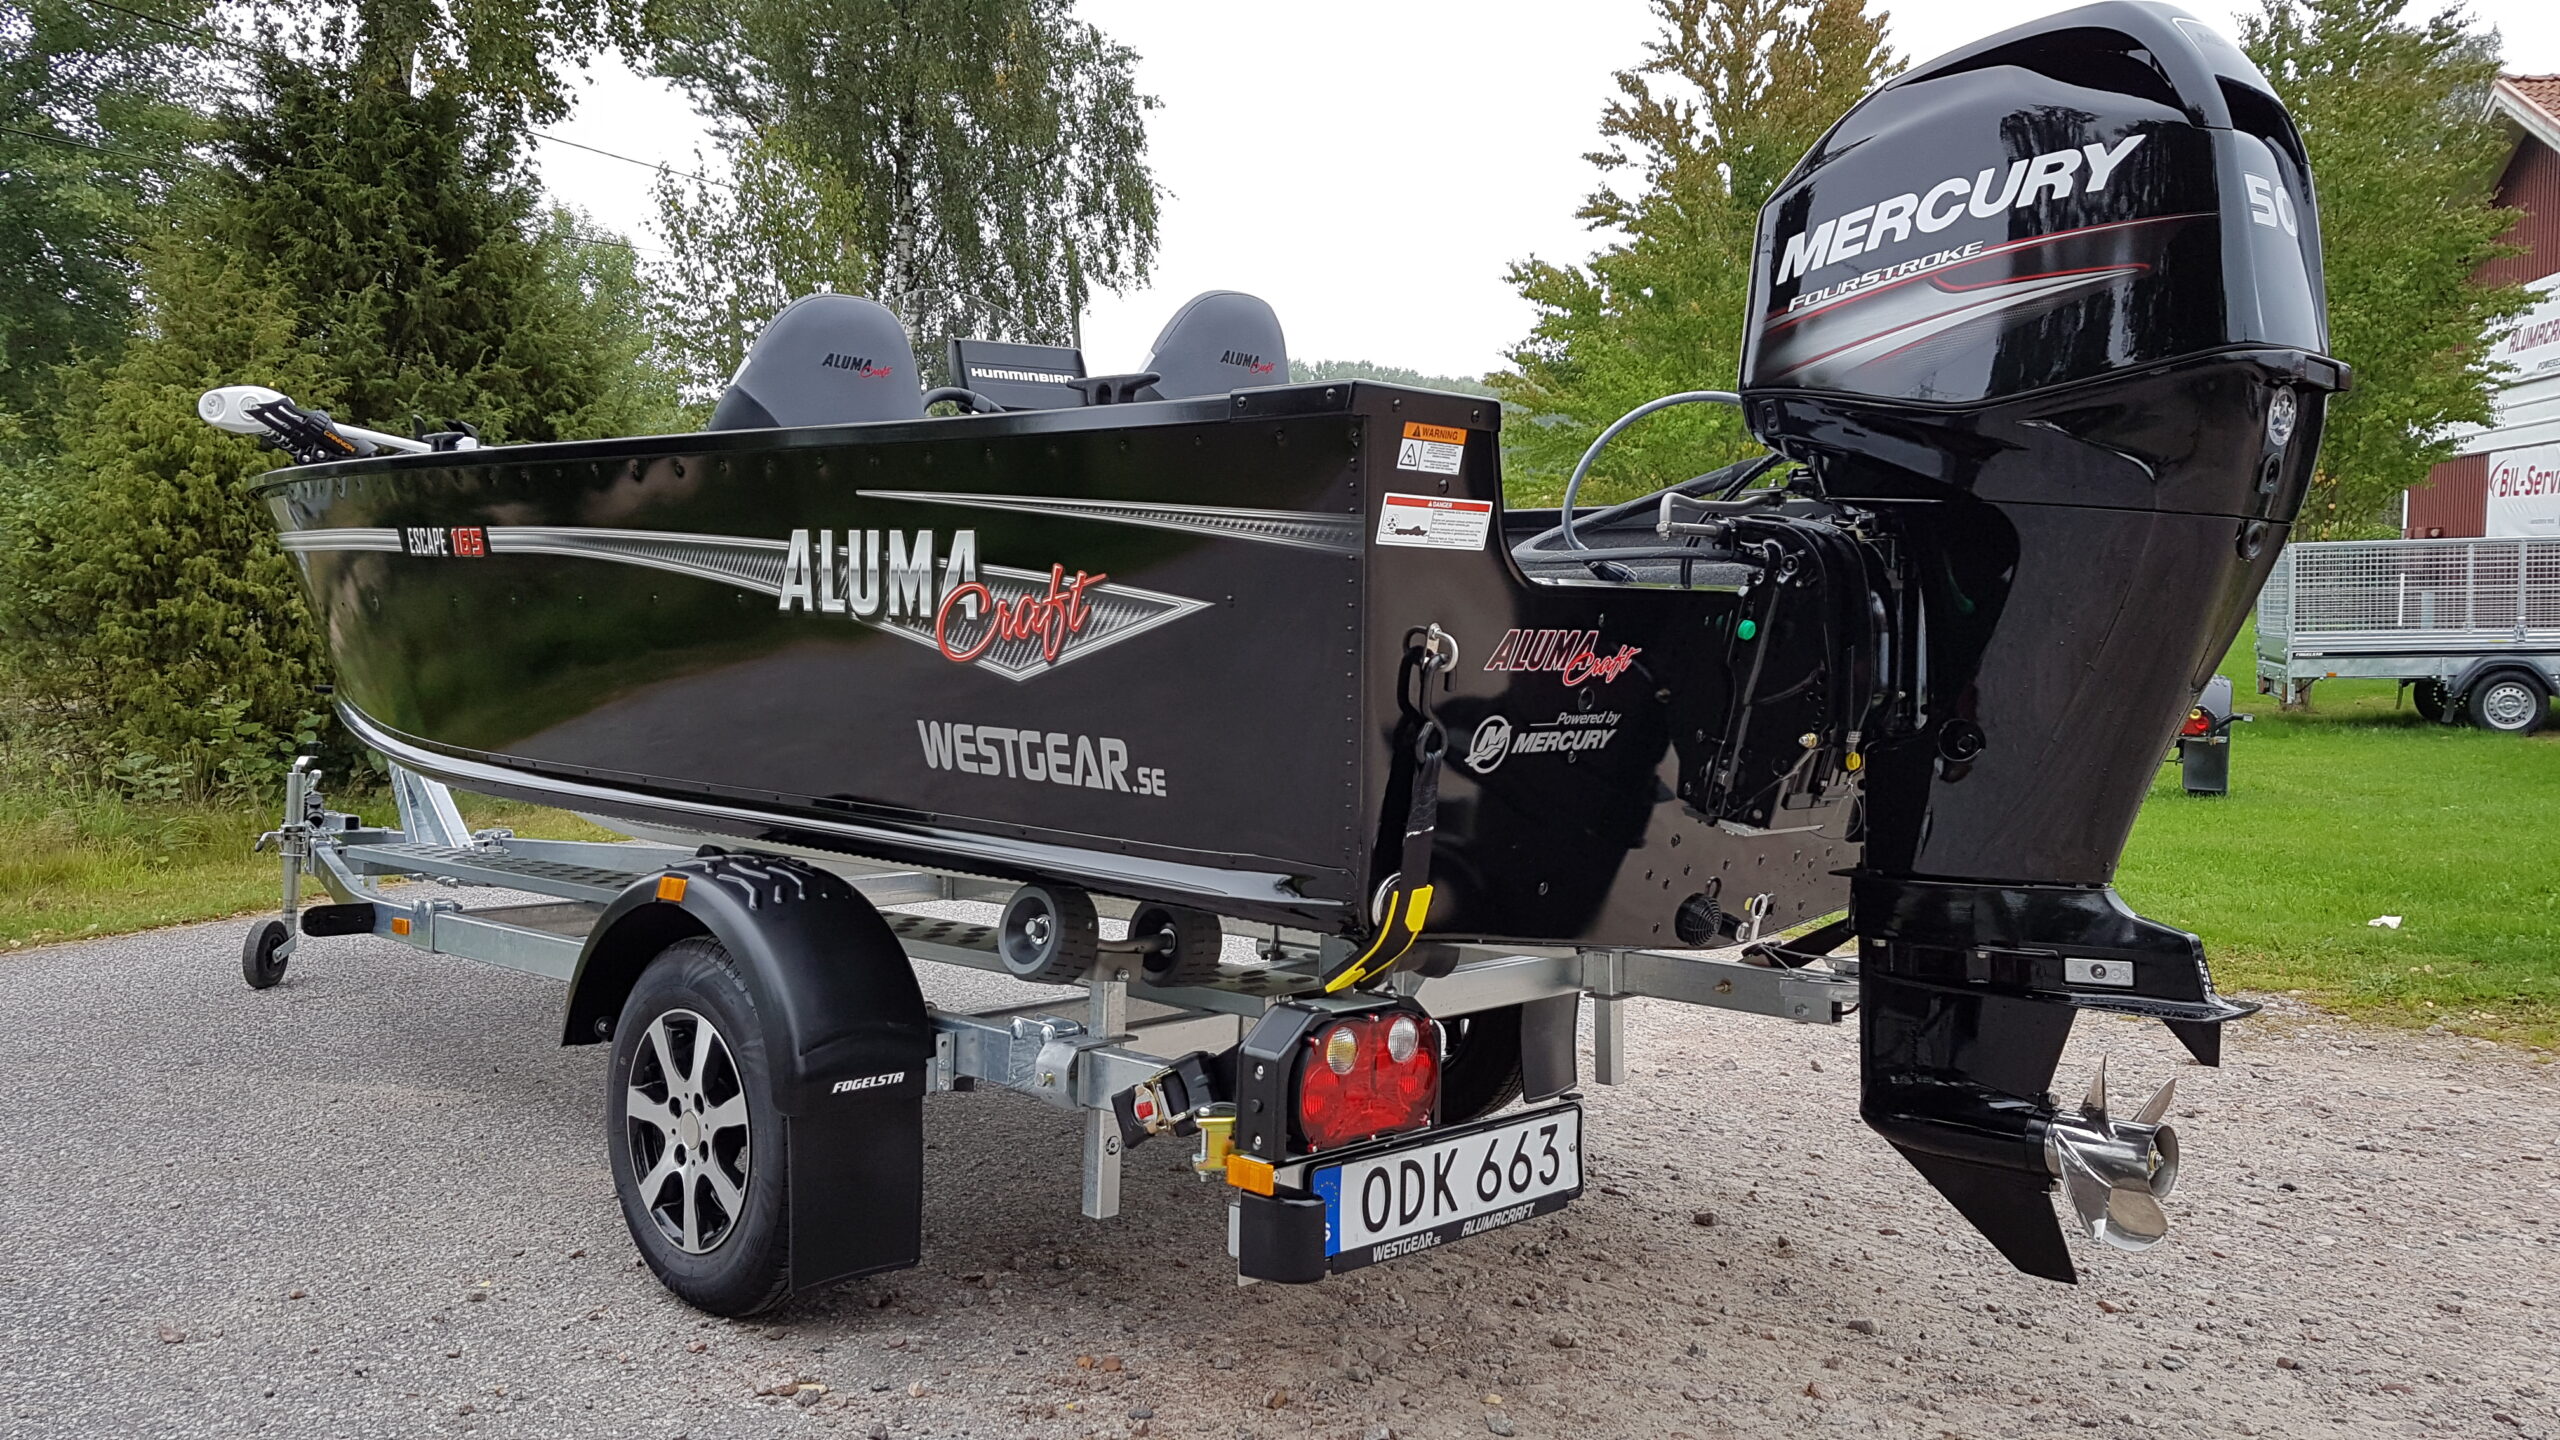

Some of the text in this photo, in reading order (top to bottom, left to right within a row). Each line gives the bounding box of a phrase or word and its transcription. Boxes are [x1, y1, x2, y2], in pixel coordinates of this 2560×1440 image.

[1776, 133, 2147, 286] MERCURY
[1787, 240, 1984, 314] FOURSTROKE
[2507, 318, 2560, 354] ALUMACR
[822, 353, 872, 373] ALUMA
[970, 367, 1075, 384] HUMMINBIRD
[1220, 350, 1260, 369] ALUMA
[1422, 429, 1458, 440] WARNING
[2499, 465, 2560, 497] BIL-Serv
[407, 526, 485, 557] ESCAPE 165
[779, 529, 1107, 662] ALUMA Craft
[1484, 629, 1642, 687] ALUMA Craft
[1557, 711, 1621, 726] Powered by
[1511, 728, 1617, 754] MERCURY
[917, 719, 1167, 797] WESTGEAR.SE
[831, 1071, 905, 1094] FOGELSTA
[1362, 1123, 1562, 1233] ODK 663
[1461, 1202, 1535, 1237] ALUMACRAFT
